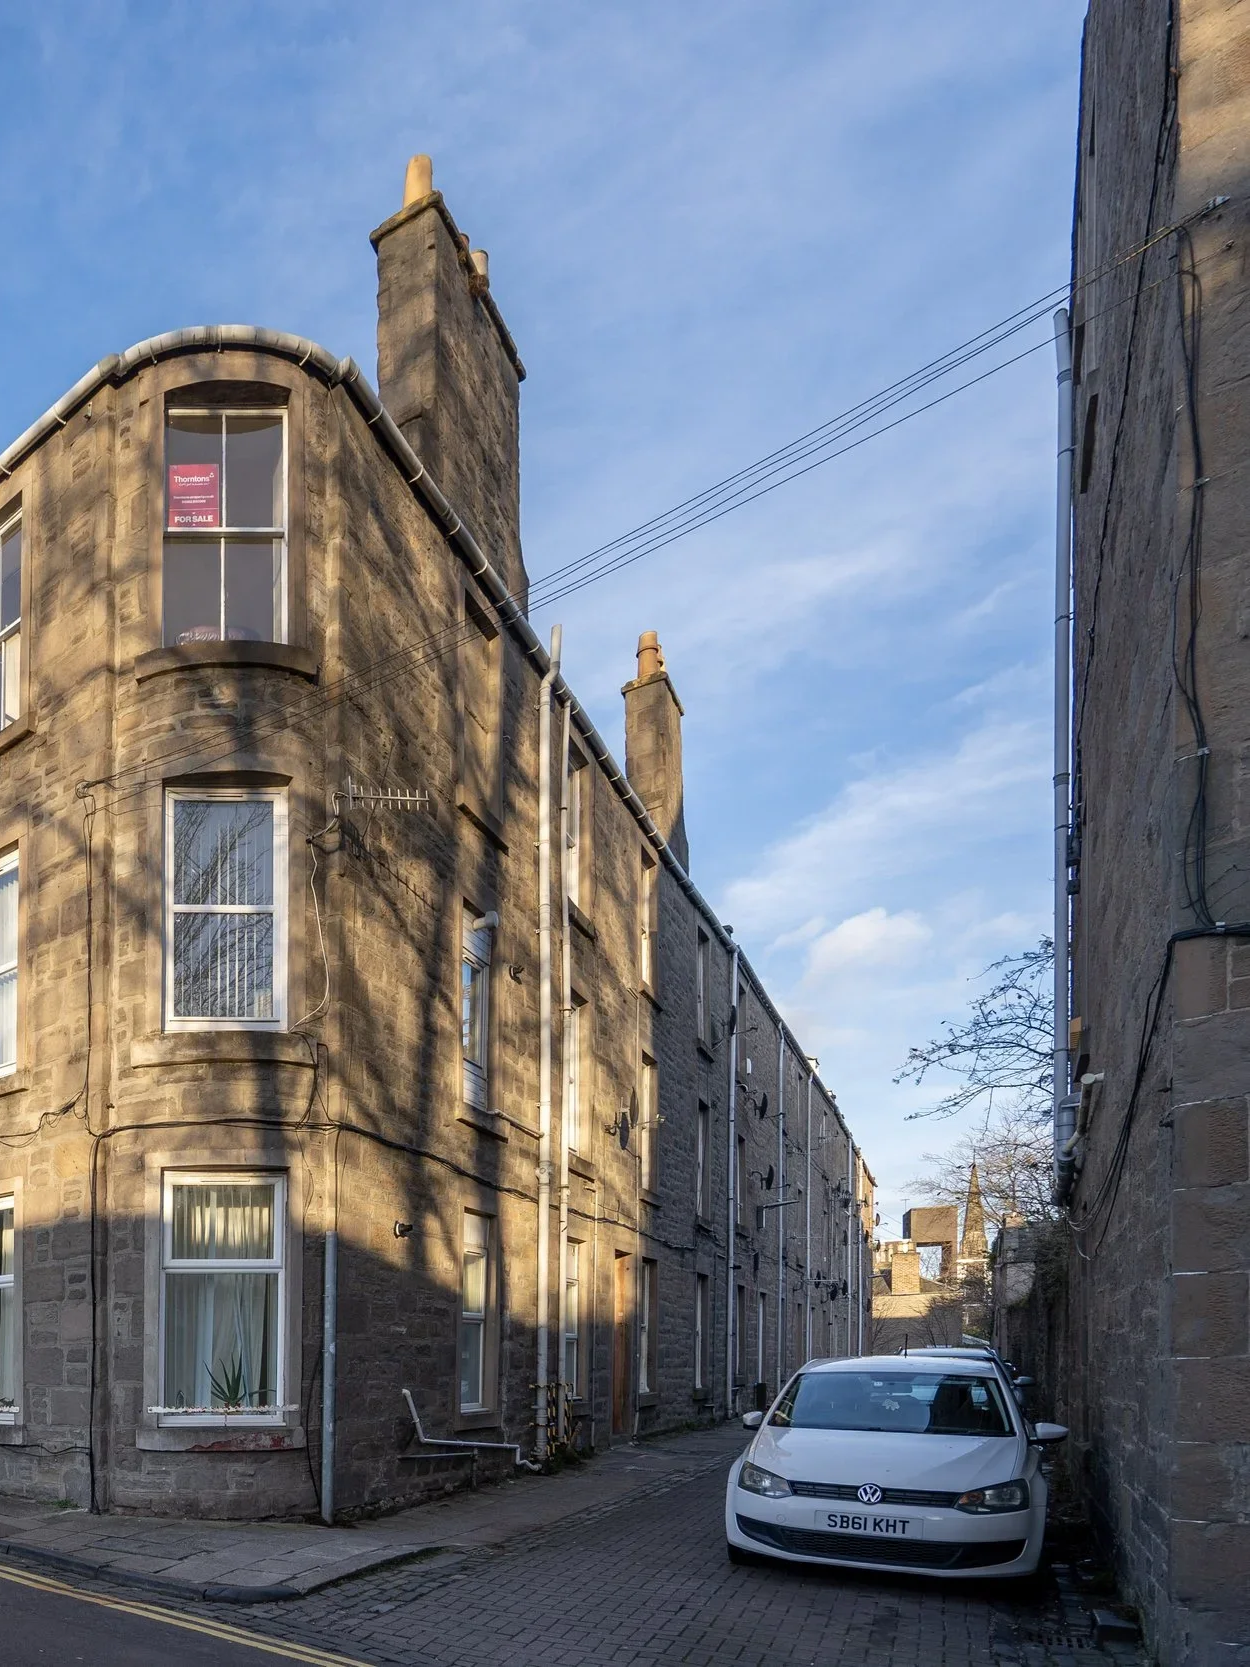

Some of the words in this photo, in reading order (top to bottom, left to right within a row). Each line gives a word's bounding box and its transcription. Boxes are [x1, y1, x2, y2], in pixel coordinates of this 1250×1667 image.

[192, 515, 213, 523] SALE
[827, 1513, 868, 1531] SB61
[872, 1517, 910, 1535] KHT
